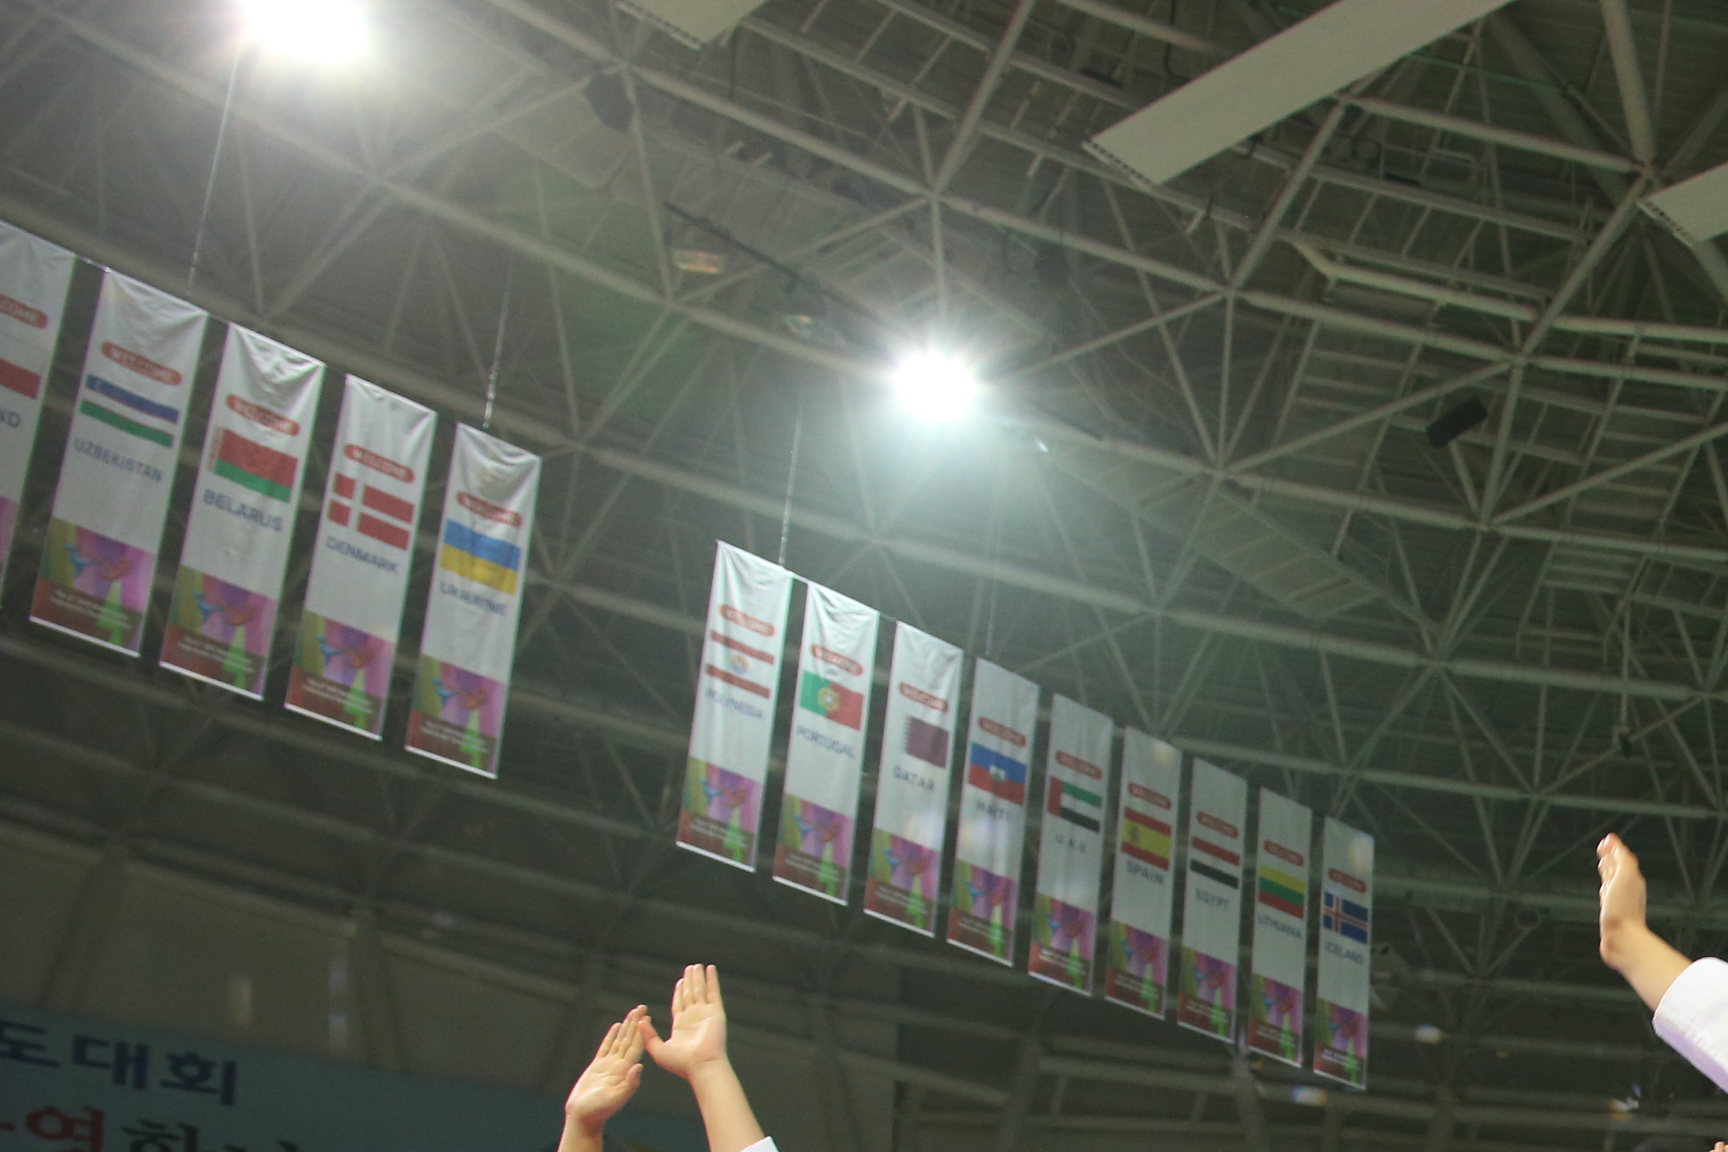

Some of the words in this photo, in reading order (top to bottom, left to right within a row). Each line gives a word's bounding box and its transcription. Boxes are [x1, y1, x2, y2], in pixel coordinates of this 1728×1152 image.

[73, 438, 162, 482] UZBEKISTAN
[203, 488, 283, 532] BELARUS
[325, 535, 399, 574] DENMARK
[796, 724, 856, 758] PORTUGAL
[892, 764, 936, 792] QATAR
[1125, 858, 1164, 884] SPAIN
[1256, 913, 1303, 939] LITHUANIA
[1324, 941, 1364, 965] ICELAND
